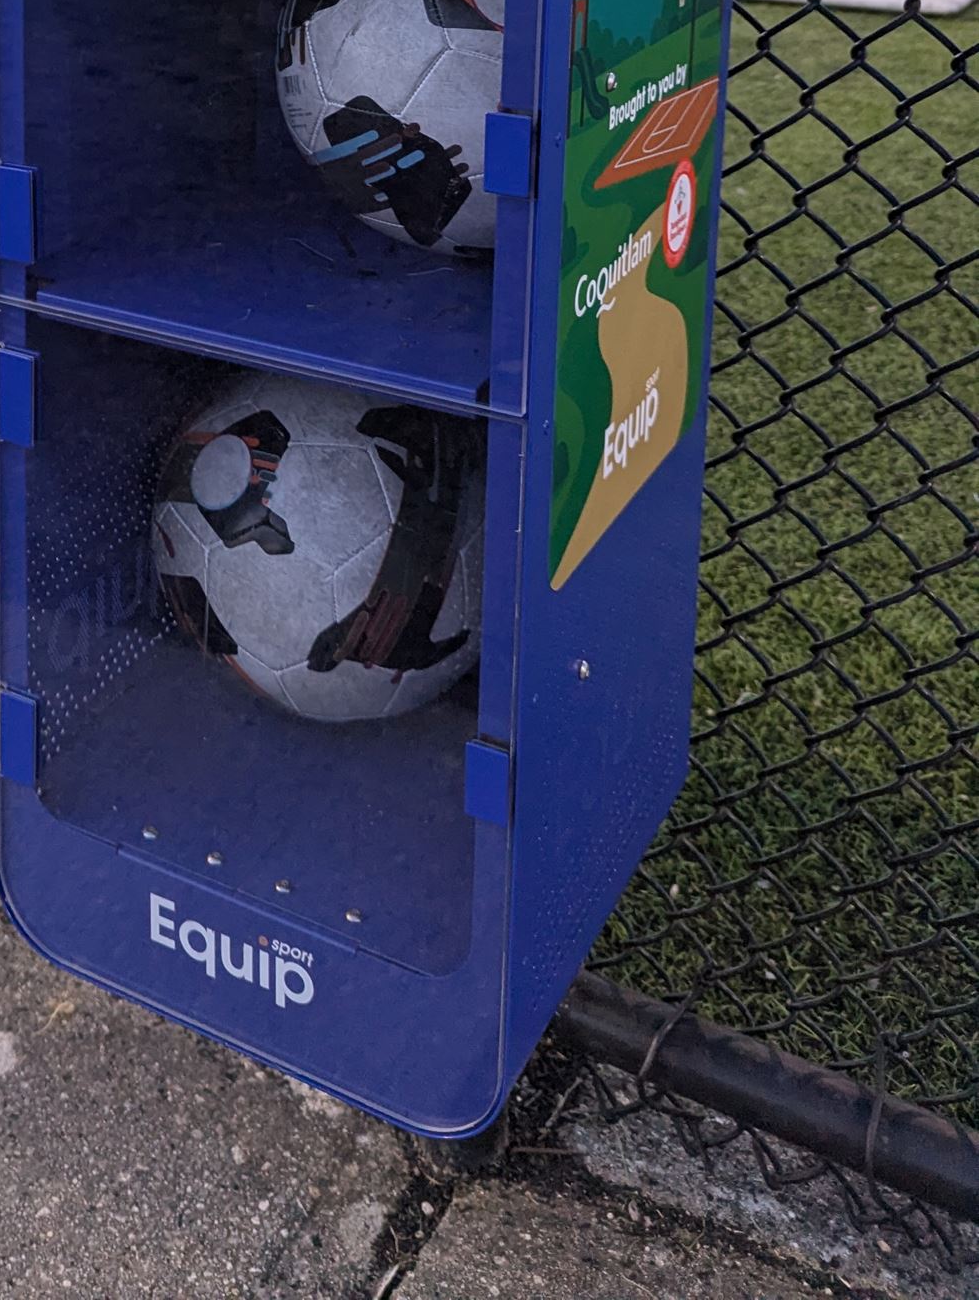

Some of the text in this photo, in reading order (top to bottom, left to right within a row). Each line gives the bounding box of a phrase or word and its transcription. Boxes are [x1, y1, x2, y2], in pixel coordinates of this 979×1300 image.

[609, 63, 687, 131] Brought to you by
[574, 229, 653, 319] Coquitlam
[602, 386, 660, 480] Equip
[150, 892, 315, 1009] Equip
[271, 937, 315, 968] sport
